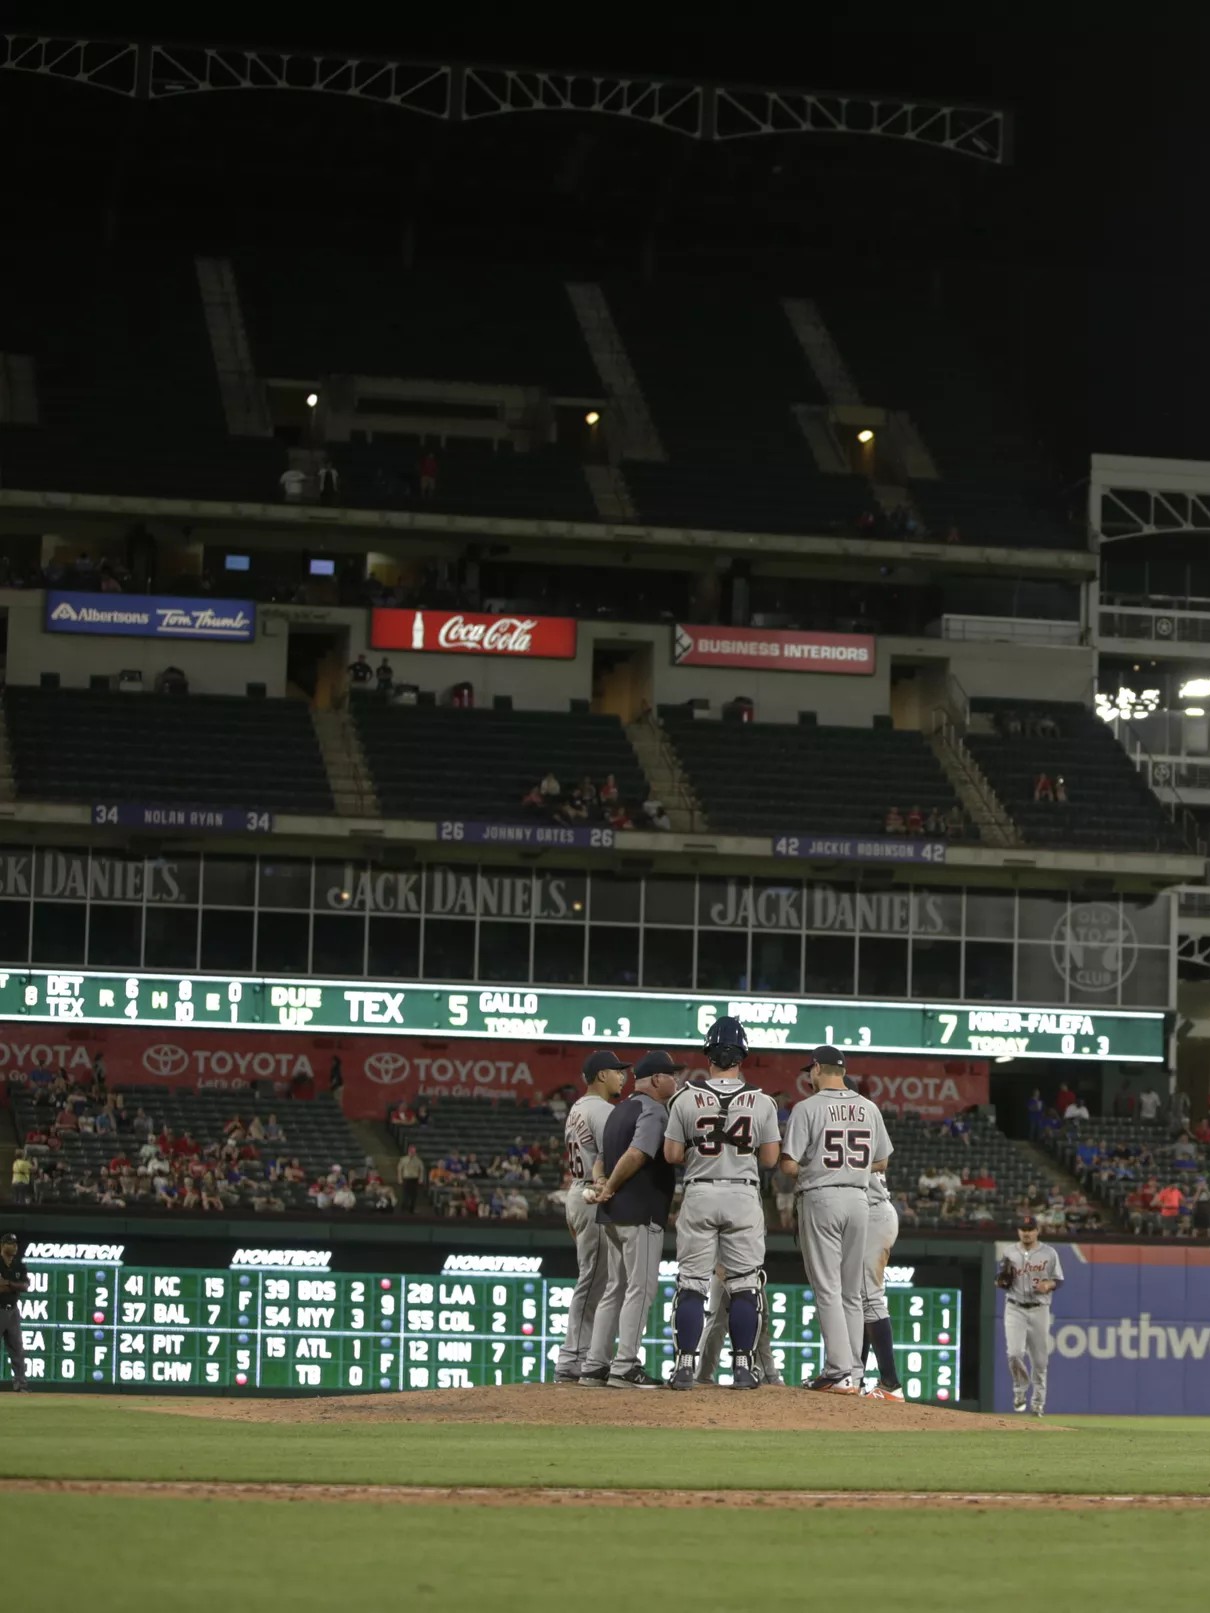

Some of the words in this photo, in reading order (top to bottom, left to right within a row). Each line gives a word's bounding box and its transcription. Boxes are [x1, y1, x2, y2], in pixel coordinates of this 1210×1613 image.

[78, 607, 149, 625] Albertsons
[156, 608, 192, 627] Tom
[191, 608, 250, 629] Thumb
[697, 639, 780, 656] BUSINESS
[784, 644, 869, 661] INTERIORS
[95, 805, 119, 824] 34
[143, 808, 185, 825] NOLAN
[190, 811, 224, 827] RYAN
[246, 812, 271, 832] 34
[441, 822, 464, 840] 26
[482, 826, 531, 841] JOHNNY
[536, 828, 575, 843] OATES
[590, 828, 613, 847] 26
[776, 837, 799, 856] 42
[809, 840, 851, 856] JACKIE
[921, 843, 944, 862] 42
[326, 861, 422, 911] JACK
[710, 878, 800, 927] JACK
[47, 975, 84, 996] DET
[125, 978, 140, 999] 6
[228, 982, 242, 1002] 0
[99, 989, 115, 1007] R
[152, 991, 168, 1009] H
[206, 993, 220, 1011] E
[271, 986, 322, 1007] DUE
[344, 991, 405, 1023] TEX
[46, 997, 85, 1018] TEX
[124, 1000, 138, 1019] 4
[175, 1001, 194, 1022] 10
[230, 1003, 238, 1024] 1
[279, 1007, 314, 1027] UP
[448, 995, 468, 1025] 5
[479, 992, 538, 1014] GALLO
[484, 1017, 548, 1035] TODAY
[697, 1004, 717, 1035] 6
[938, 1014, 957, 1043] 7
[968, 1036, 1029, 1053] TODAY
[192, 1050, 314, 1078] TOYOTA
[413, 1058, 534, 1085] TOYOTA
[828, 1104, 866, 1123] HICKS
[695, 1114, 756, 1157] 34
[822, 1129, 872, 1170] 55
[24, 1243, 125, 1260] NOVATECH
[26, 1272, 48, 1292] OU
[67, 1274, 75, 1294] 1
[124, 1275, 143, 1295] 41
[154, 1276, 181, 1297] KC
[205, 1278, 224, 1298] 15
[265, 1279, 290, 1300] 39
[298, 1280, 336, 1301] BOS
[351, 1282, 365, 1302] 2
[95, 1288, 109, 1307] 2
[239, 1291, 252, 1311] F
[380, 1295, 394, 1315] 9
[407, 1283, 433, 1304] 28
[439, 1284, 475, 1305] LAA
[493, 1286, 507, 1306] 0
[772, 1292, 786, 1313] 2
[67, 1301, 74, 1320] 1
[122, 1303, 146, 1323] 37
[153, 1303, 190, 1324] BAL
[208, 1305, 220, 1324] 7
[522, 1299, 536, 1319] 6
[802, 1306, 816, 1326] F
[909, 1296, 924, 1317] 2
[265, 1306, 291, 1327] 54
[297, 1307, 335, 1328] NYY
[351, 1309, 364, 1329] 3
[407, 1310, 434, 1331] 55
[439, 1311, 475, 1332] COL
[492, 1312, 506, 1333] 2
[941, 1308, 950, 1329] 1
[772, 1319, 786, 1339] 7
[912, 1322, 921, 1343] 1
[21, 1331, 45, 1351] EA
[62, 1332, 75, 1351] 5
[120, 1334, 145, 1353] 24
[153, 1335, 185, 1354] PIT
[207, 1335, 220, 1355] 7
[266, 1337, 285, 1358] 15
[296, 1338, 332, 1359] ATL
[353, 1339, 361, 1359] 1
[94, 1346, 107, 1365] F
[236, 1350, 250, 1370] 5
[409, 1341, 428, 1361] 12
[438, 1341, 471, 1362] MIN
[492, 1343, 505, 1363] 7
[907, 1352, 922, 1373] 0
[61, 1359, 75, 1378] 0
[120, 1361, 145, 1380] 66
[152, 1361, 191, 1381] CHW
[206, 1363, 219, 1382] 5
[380, 1353, 394, 1373] F
[522, 1357, 536, 1377] F
[349, 1366, 362, 1386] 0
[438, 1368, 474, 1388] STL
[495, 1370, 502, 1386] 1
[937, 1366, 951, 1385] 2
[907, 1378, 922, 1398] 0
